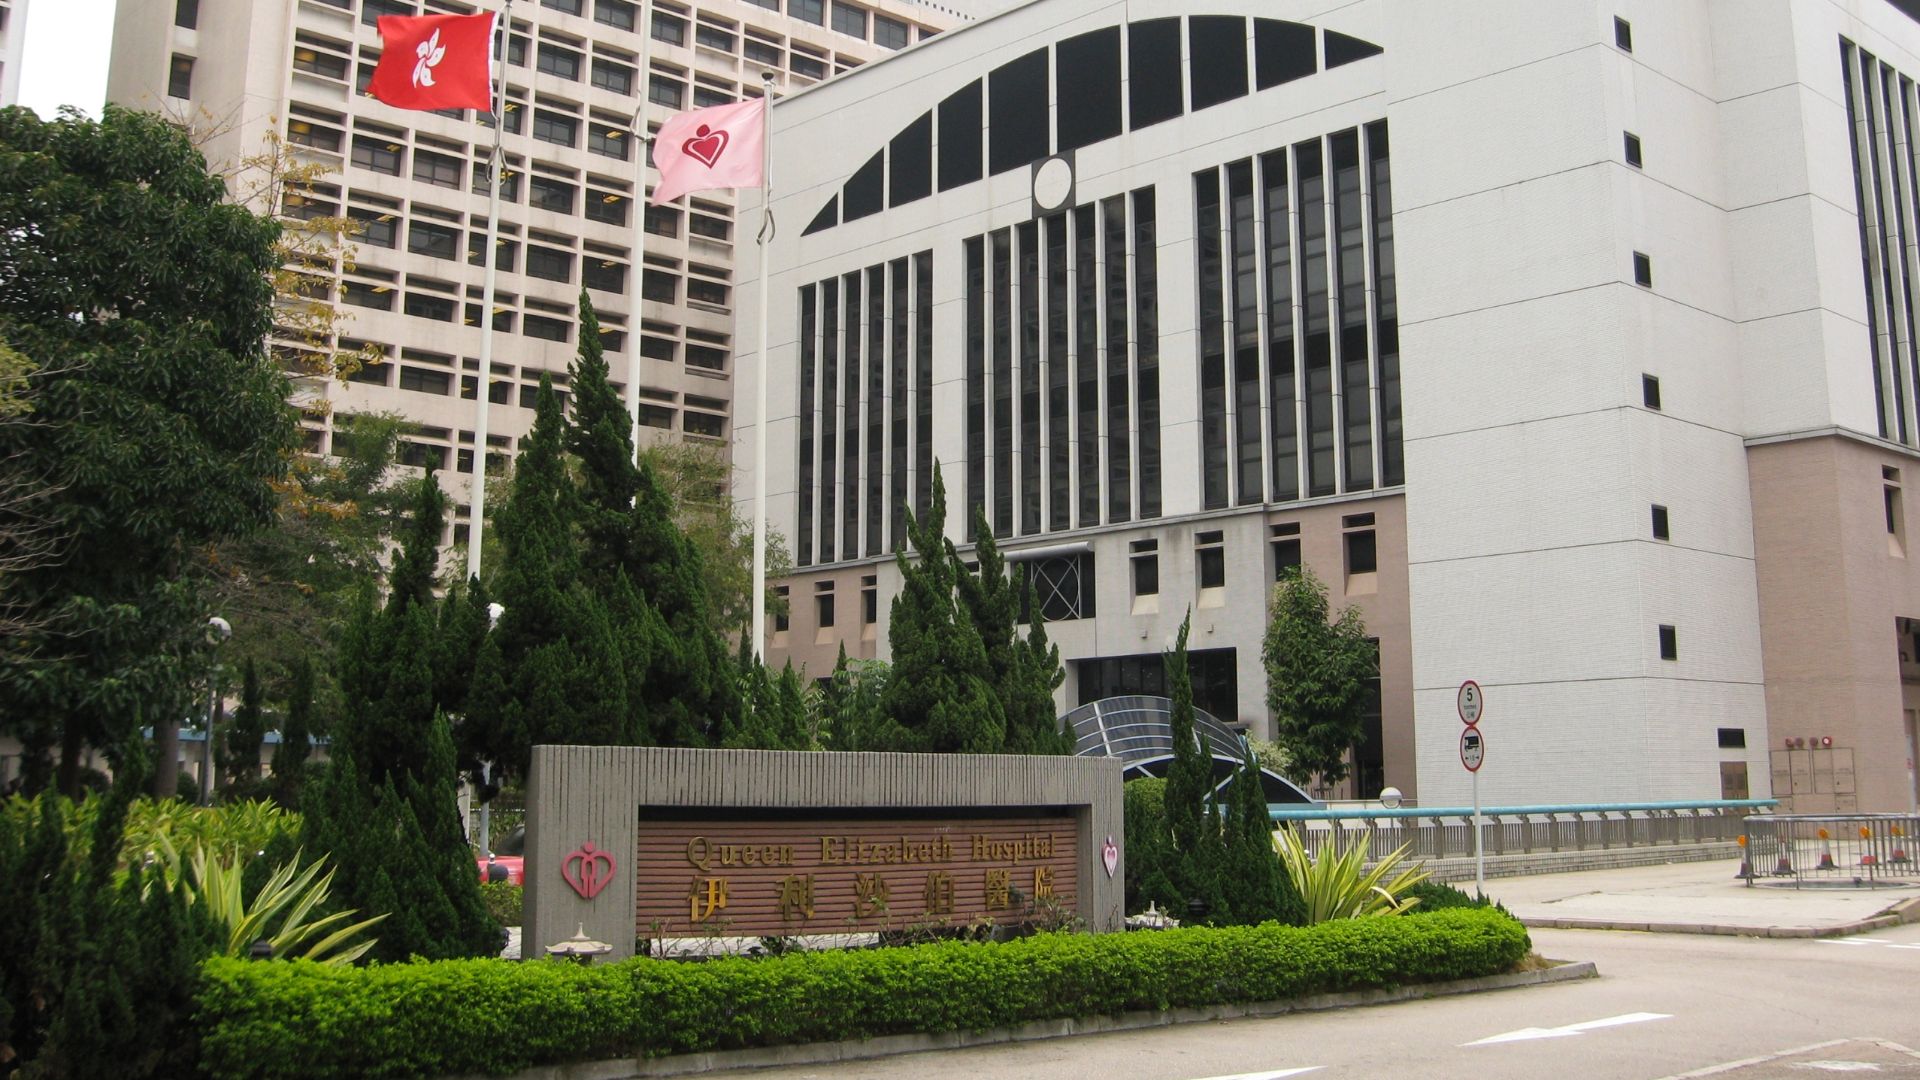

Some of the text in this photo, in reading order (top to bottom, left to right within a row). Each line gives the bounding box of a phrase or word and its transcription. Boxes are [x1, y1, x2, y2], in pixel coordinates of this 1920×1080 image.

[1466, 687, 1473, 702] 5
[687, 832, 1057, 871] Queen Elizabeth Hospital
[687, 865, 1056, 922] 伊利沙伯醫院
